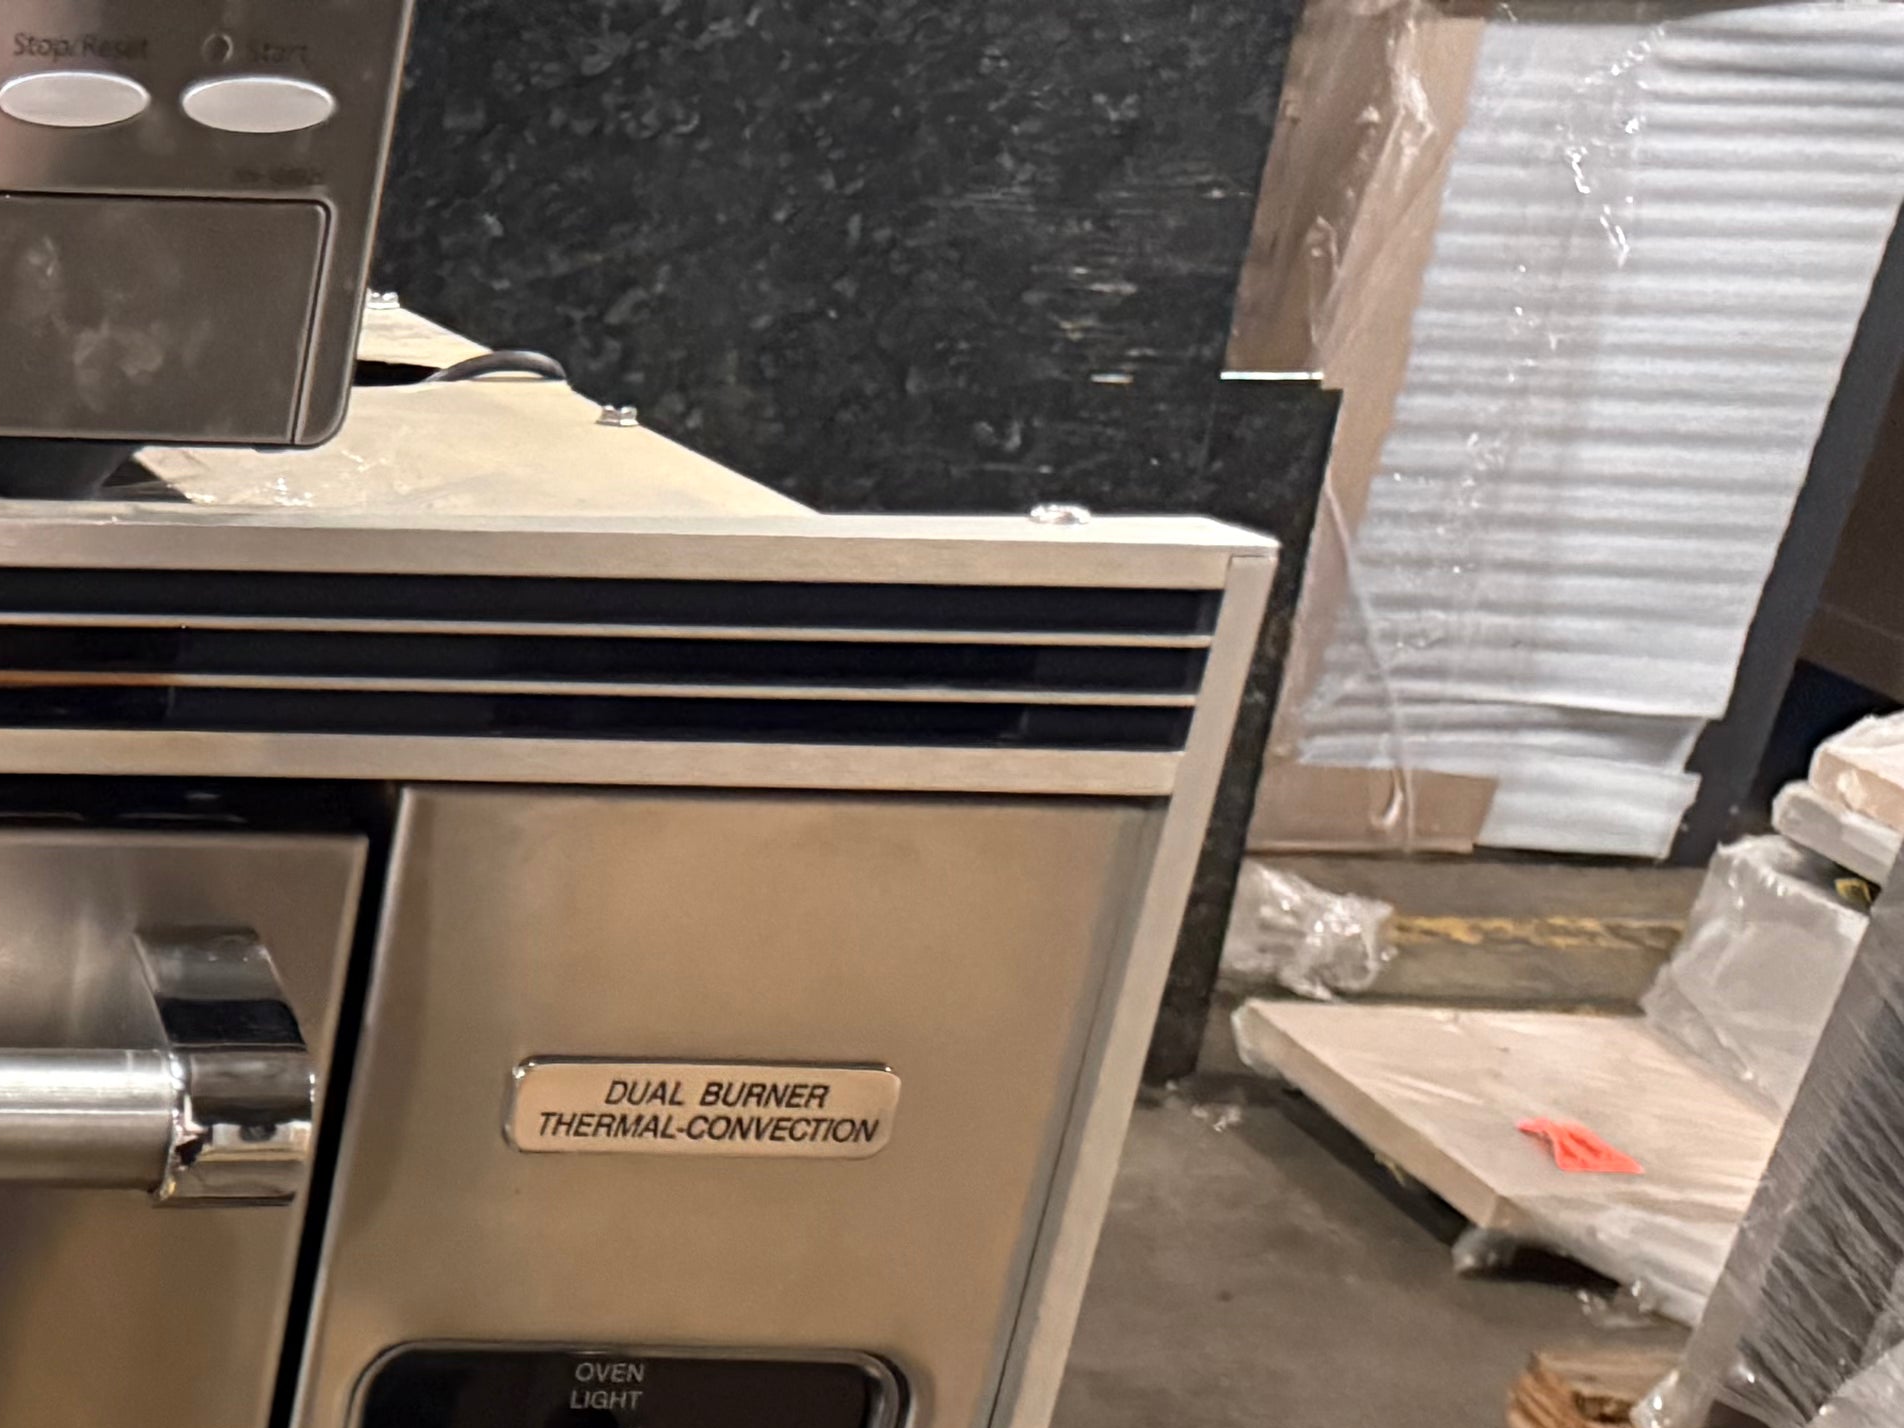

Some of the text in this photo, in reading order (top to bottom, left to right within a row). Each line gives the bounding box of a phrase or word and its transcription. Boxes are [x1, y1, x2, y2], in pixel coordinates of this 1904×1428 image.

[604, 1079, 830, 1109] DUAL BURNER
[539, 1112, 880, 1143] THERMAL-CONVECTION
[574, 1362, 645, 1385] OVEN
[570, 1389, 643, 1411] LIGHT
